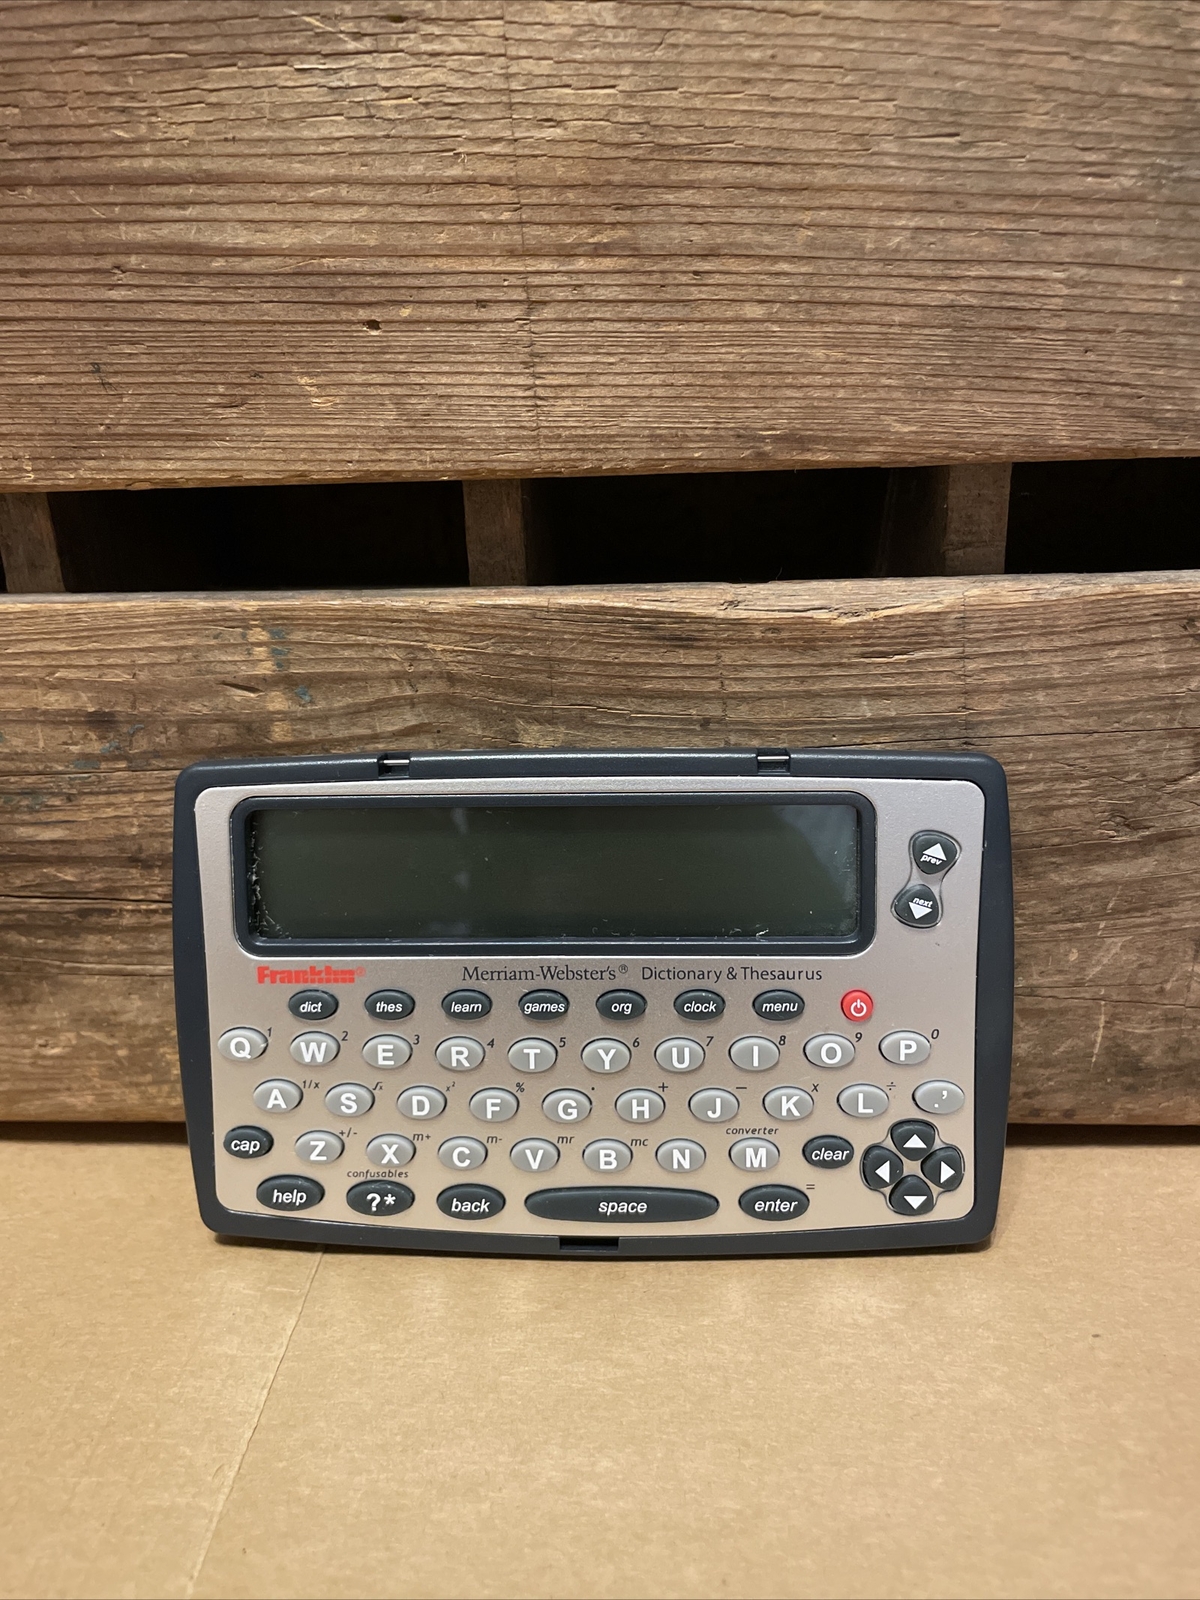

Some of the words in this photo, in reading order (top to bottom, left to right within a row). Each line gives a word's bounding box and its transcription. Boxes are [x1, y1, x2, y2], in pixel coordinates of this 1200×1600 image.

[920, 854, 943, 866] prev
[912, 897, 934, 908] next
[641, 966, 723, 983] Dictionary
[726, 966, 738, 981] &
[740, 966, 823, 981] Thesaurus
[300, 1001, 323, 1013] dict
[375, 1001, 403, 1013] thes
[450, 1001, 482, 1013] learn
[523, 1002, 566, 1015] games
[611, 1002, 633, 1015] org
[683, 1000, 717, 1013] clock
[761, 1001, 799, 1013] menu
[267, 1027, 272, 1037] 1
[341, 1031, 349, 1041] 2
[413, 1034, 420, 1045] 3
[855, 1032, 863, 1043] 9
[230, 1037, 251, 1059] Q
[486, 1038, 495, 1048] 4
[558, 1037, 567, 1047] 5
[632, 1037, 640, 1047] 6
[706, 1035, 714, 1046] 7
[778, 1035, 787, 1046] 8
[300, 1042, 327, 1063] W
[377, 1044, 395, 1065] E
[451, 1046, 471, 1067] R
[671, 1047, 690, 1069] U
[752, 1045, 759, 1067] I
[820, 1042, 842, 1064] O
[899, 1039, 918, 1061] P
[523, 1048, 541, 1069] T
[597, 1048, 617, 1070] Y
[515, 1082, 525, 1093] %
[658, 1082, 669, 1092] +
[266, 1088, 287, 1109] A
[340, 1092, 358, 1114] S
[411, 1095, 431, 1116] D
[781, 1095, 800, 1117] K
[857, 1092, 874, 1114] L
[486, 1098, 501, 1119] F
[557, 1099, 578, 1120] G
[631, 1098, 650, 1119] H
[706, 1097, 721, 1119] J
[412, 1133, 431, 1142] m+
[725, 1126, 779, 1135] converter
[230, 1138, 261, 1155] cap
[556, 1135, 575, 1144] mr
[630, 1137, 649, 1147] mc
[309, 1140, 327, 1161] Z
[381, 1144, 400, 1164] X
[452, 1146, 471, 1168] C
[745, 1147, 767, 1168] M
[811, 1147, 850, 1161] clear
[524, 1149, 544, 1170] V
[599, 1149, 618, 1170] B
[672, 1149, 690, 1170] N
[346, 1169, 409, 1179] confusables
[272, 1188, 307, 1206] help
[451, 1197, 490, 1213] back
[598, 1200, 648, 1216] space
[753, 1198, 798, 1213] enter
